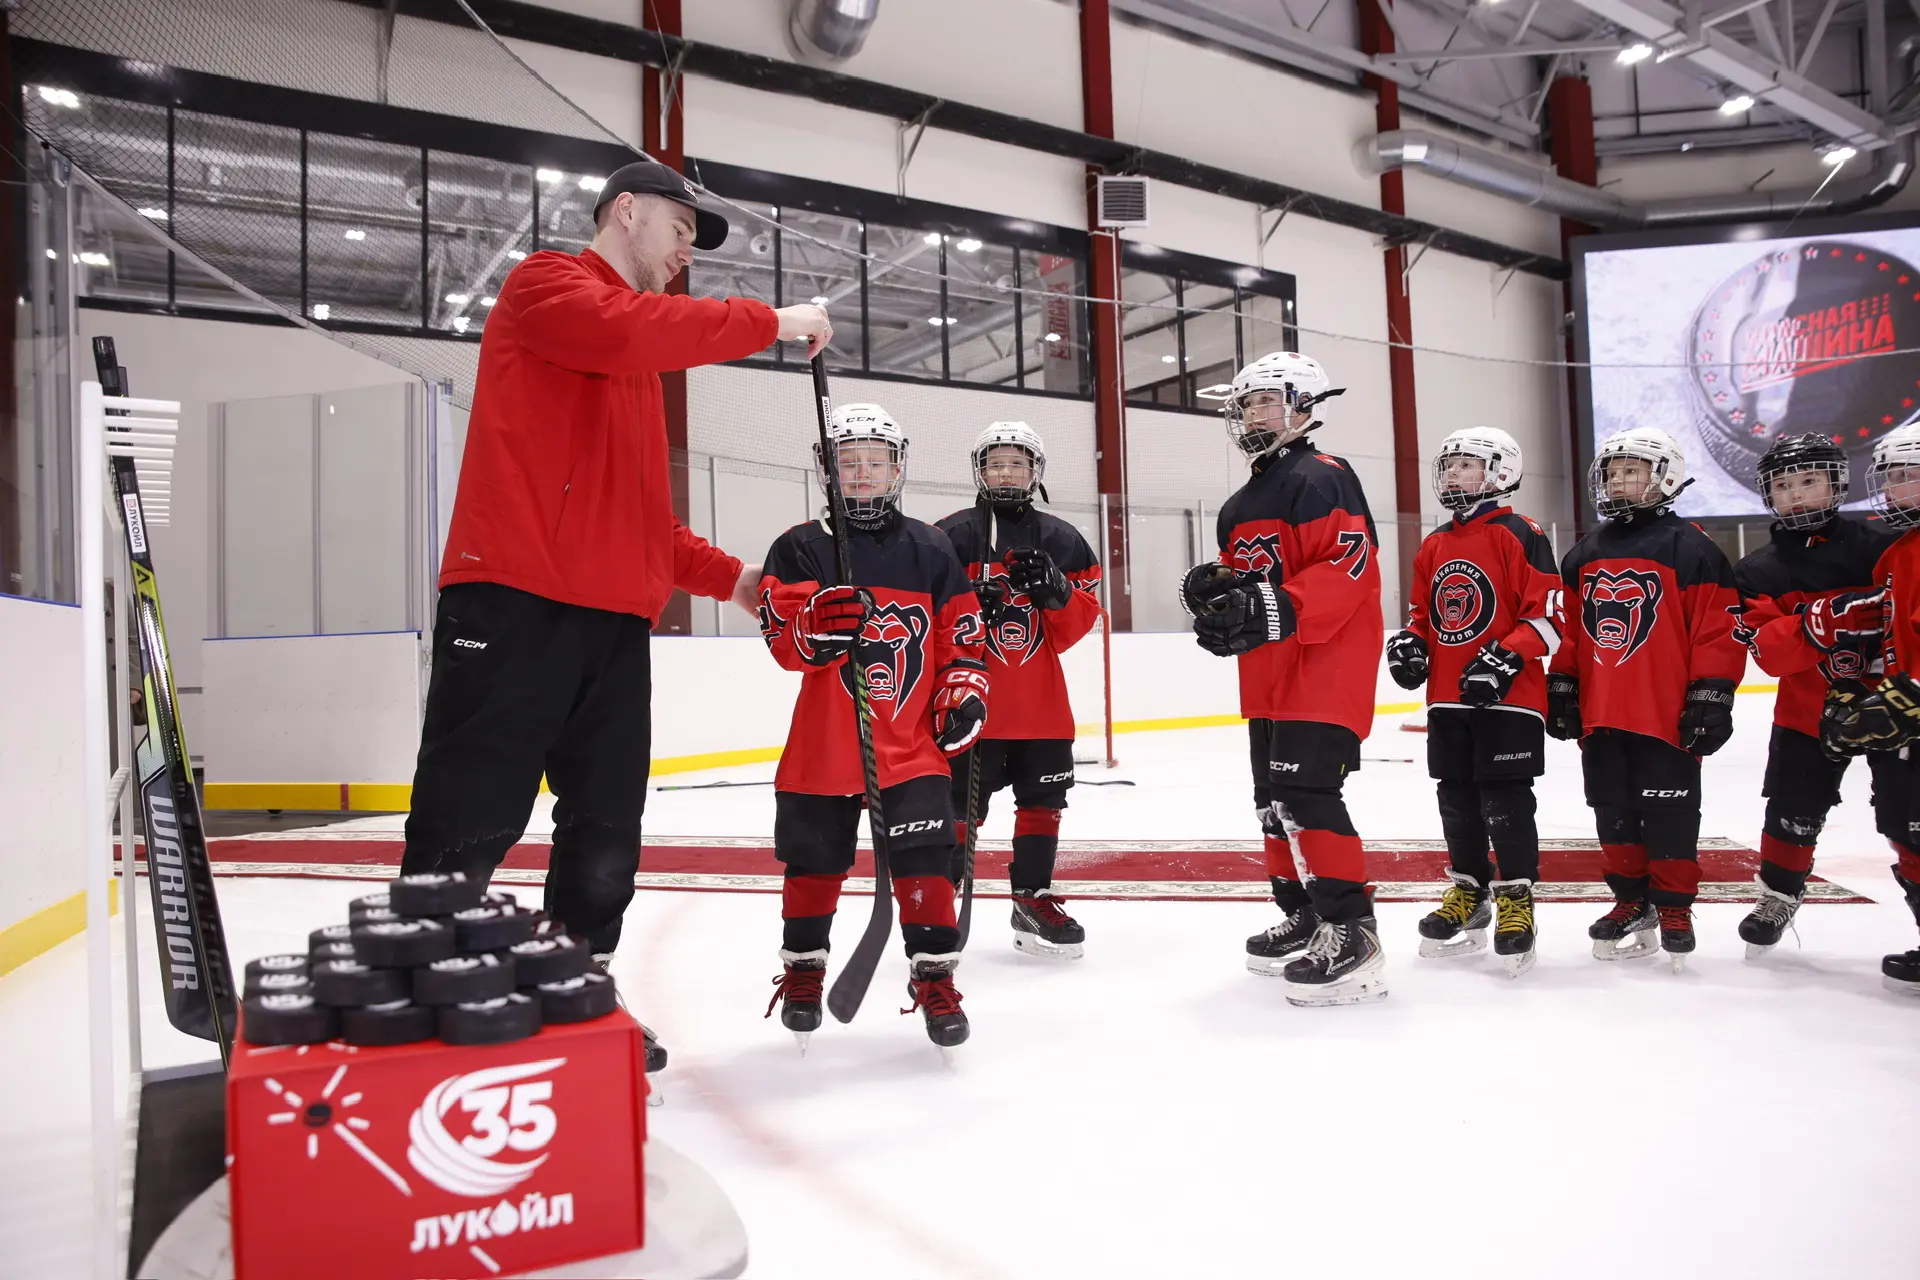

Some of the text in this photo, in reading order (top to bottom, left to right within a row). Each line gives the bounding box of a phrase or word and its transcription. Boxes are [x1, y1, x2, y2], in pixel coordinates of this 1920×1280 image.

[128, 508, 143, 548] ЛУКОЙЛ
[1434, 563, 1481, 584] АКАДЕМИЯ
[1256, 582, 1280, 641] WARRIOR
[453, 638, 488, 650] CCM
[1493, 751, 1532, 761] BAUER
[1039, 769, 1072, 784] CCM
[1642, 789, 1689, 798] CCM
[888, 818, 944, 838] CCM
[149, 795, 199, 991] WARRIOR
[459, 1080, 557, 1158] 35
[410, 1191, 575, 1253] ЛУКОЙЛ
